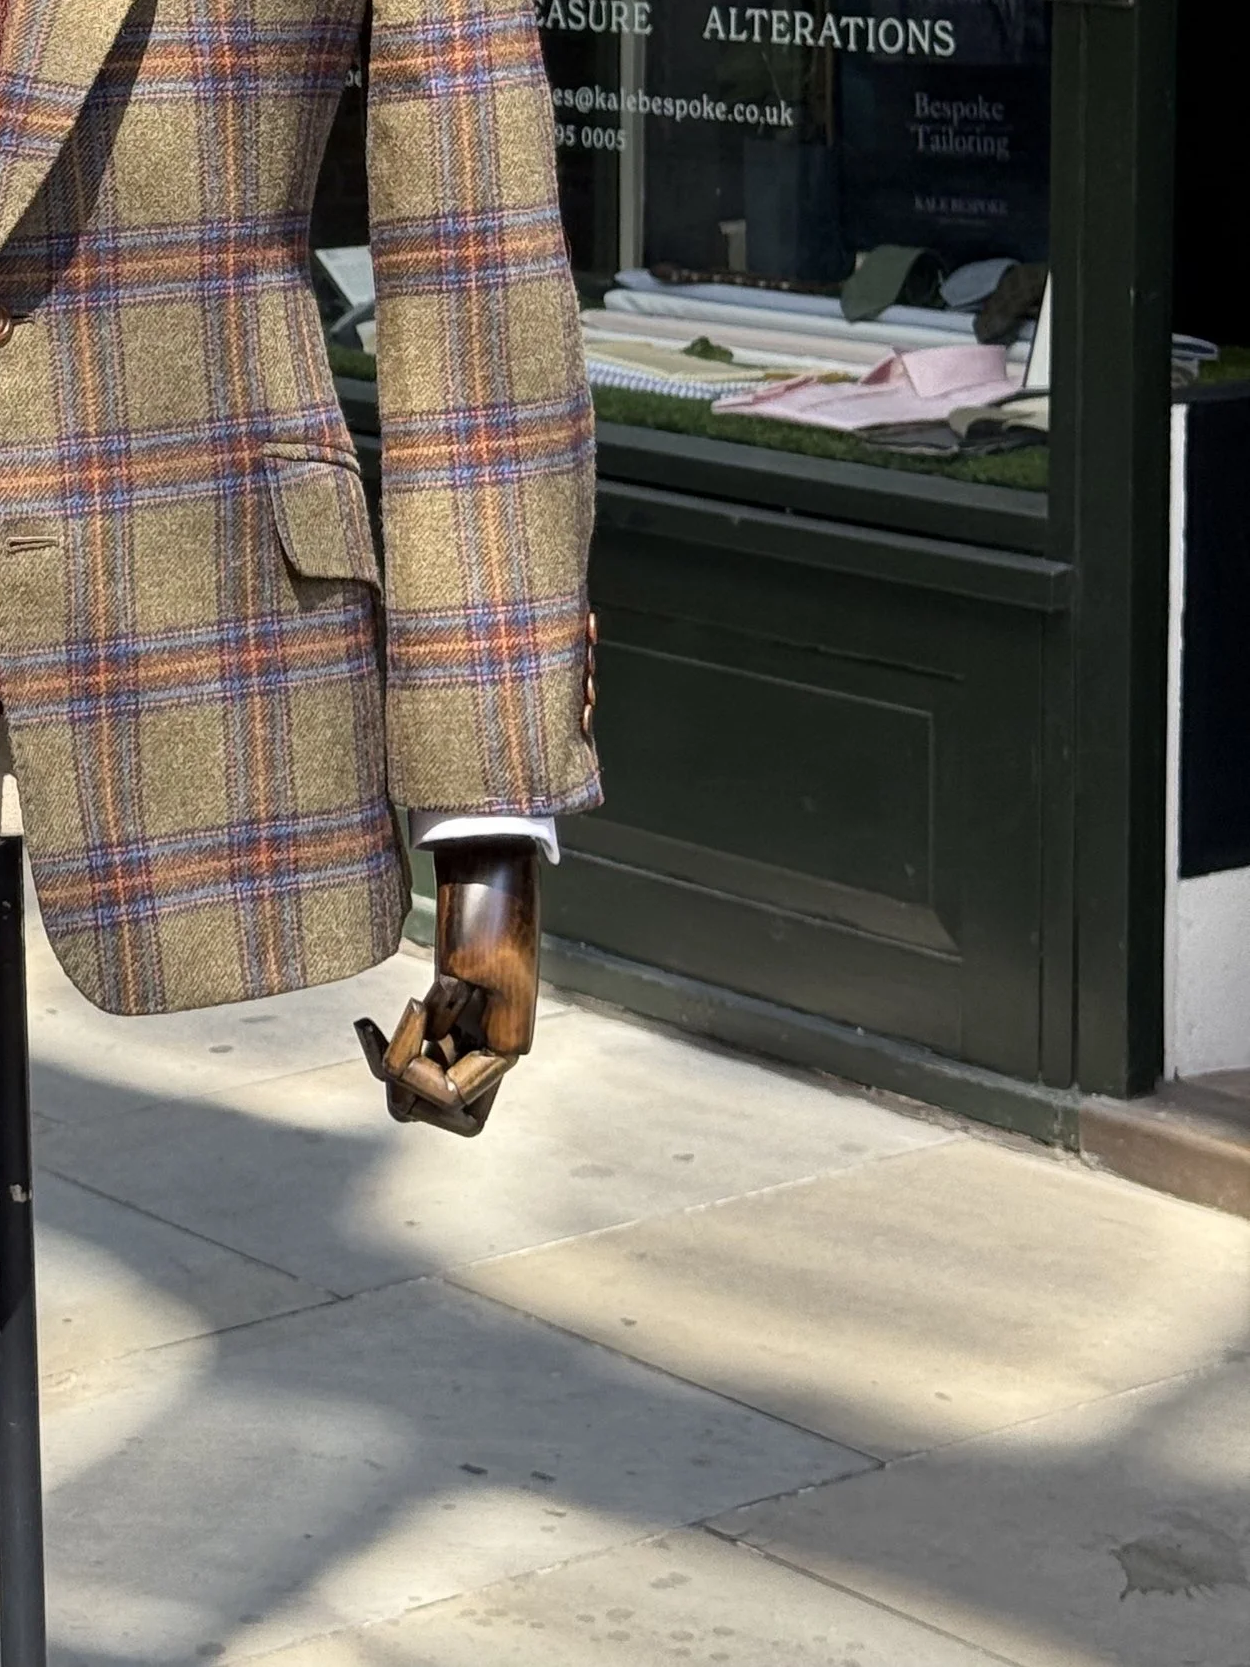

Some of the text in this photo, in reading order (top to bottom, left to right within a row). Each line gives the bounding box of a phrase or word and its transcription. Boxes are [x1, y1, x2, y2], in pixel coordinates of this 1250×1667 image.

[702, 6, 957, 56] ALTERATIONS
[552, 84, 795, 128] es@kalebespoke.co.uk
[913, 91, 1005, 127] Bespoke
[581, 126, 627, 152] 0005
[910, 123, 1012, 163] Tailoring
